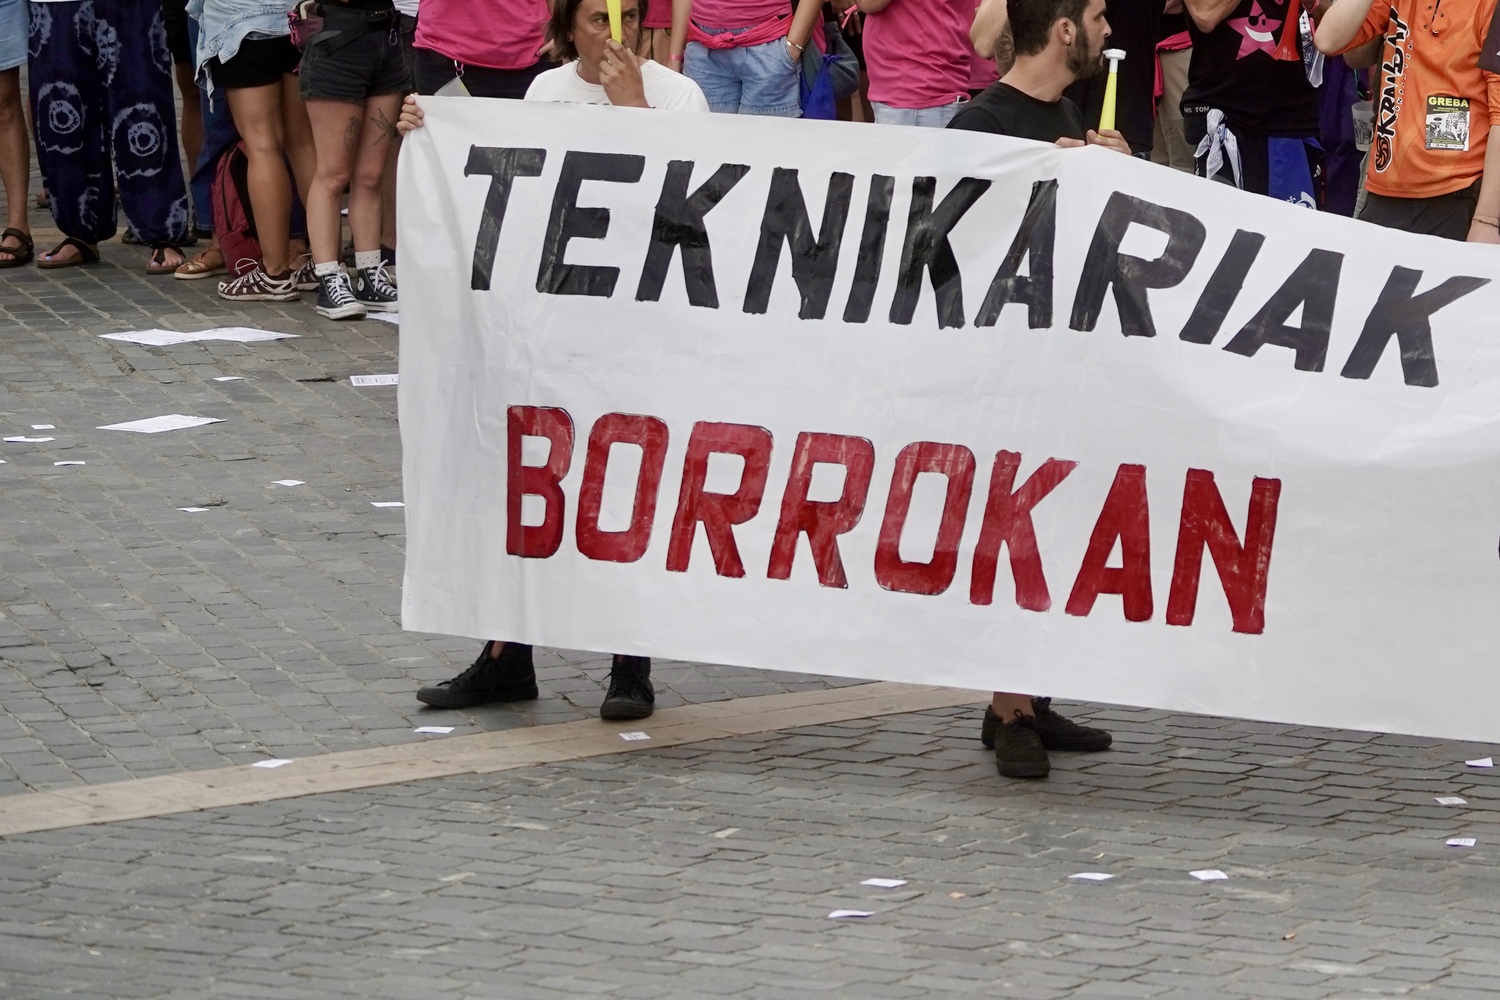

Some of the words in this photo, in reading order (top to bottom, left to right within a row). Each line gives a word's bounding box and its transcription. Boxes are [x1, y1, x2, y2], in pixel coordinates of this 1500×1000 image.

[1428, 97, 1469, 107] GREBA
[463, 144, 1492, 387] TEKNIKARIAK
[507, 404, 1281, 634] BORROKAN
